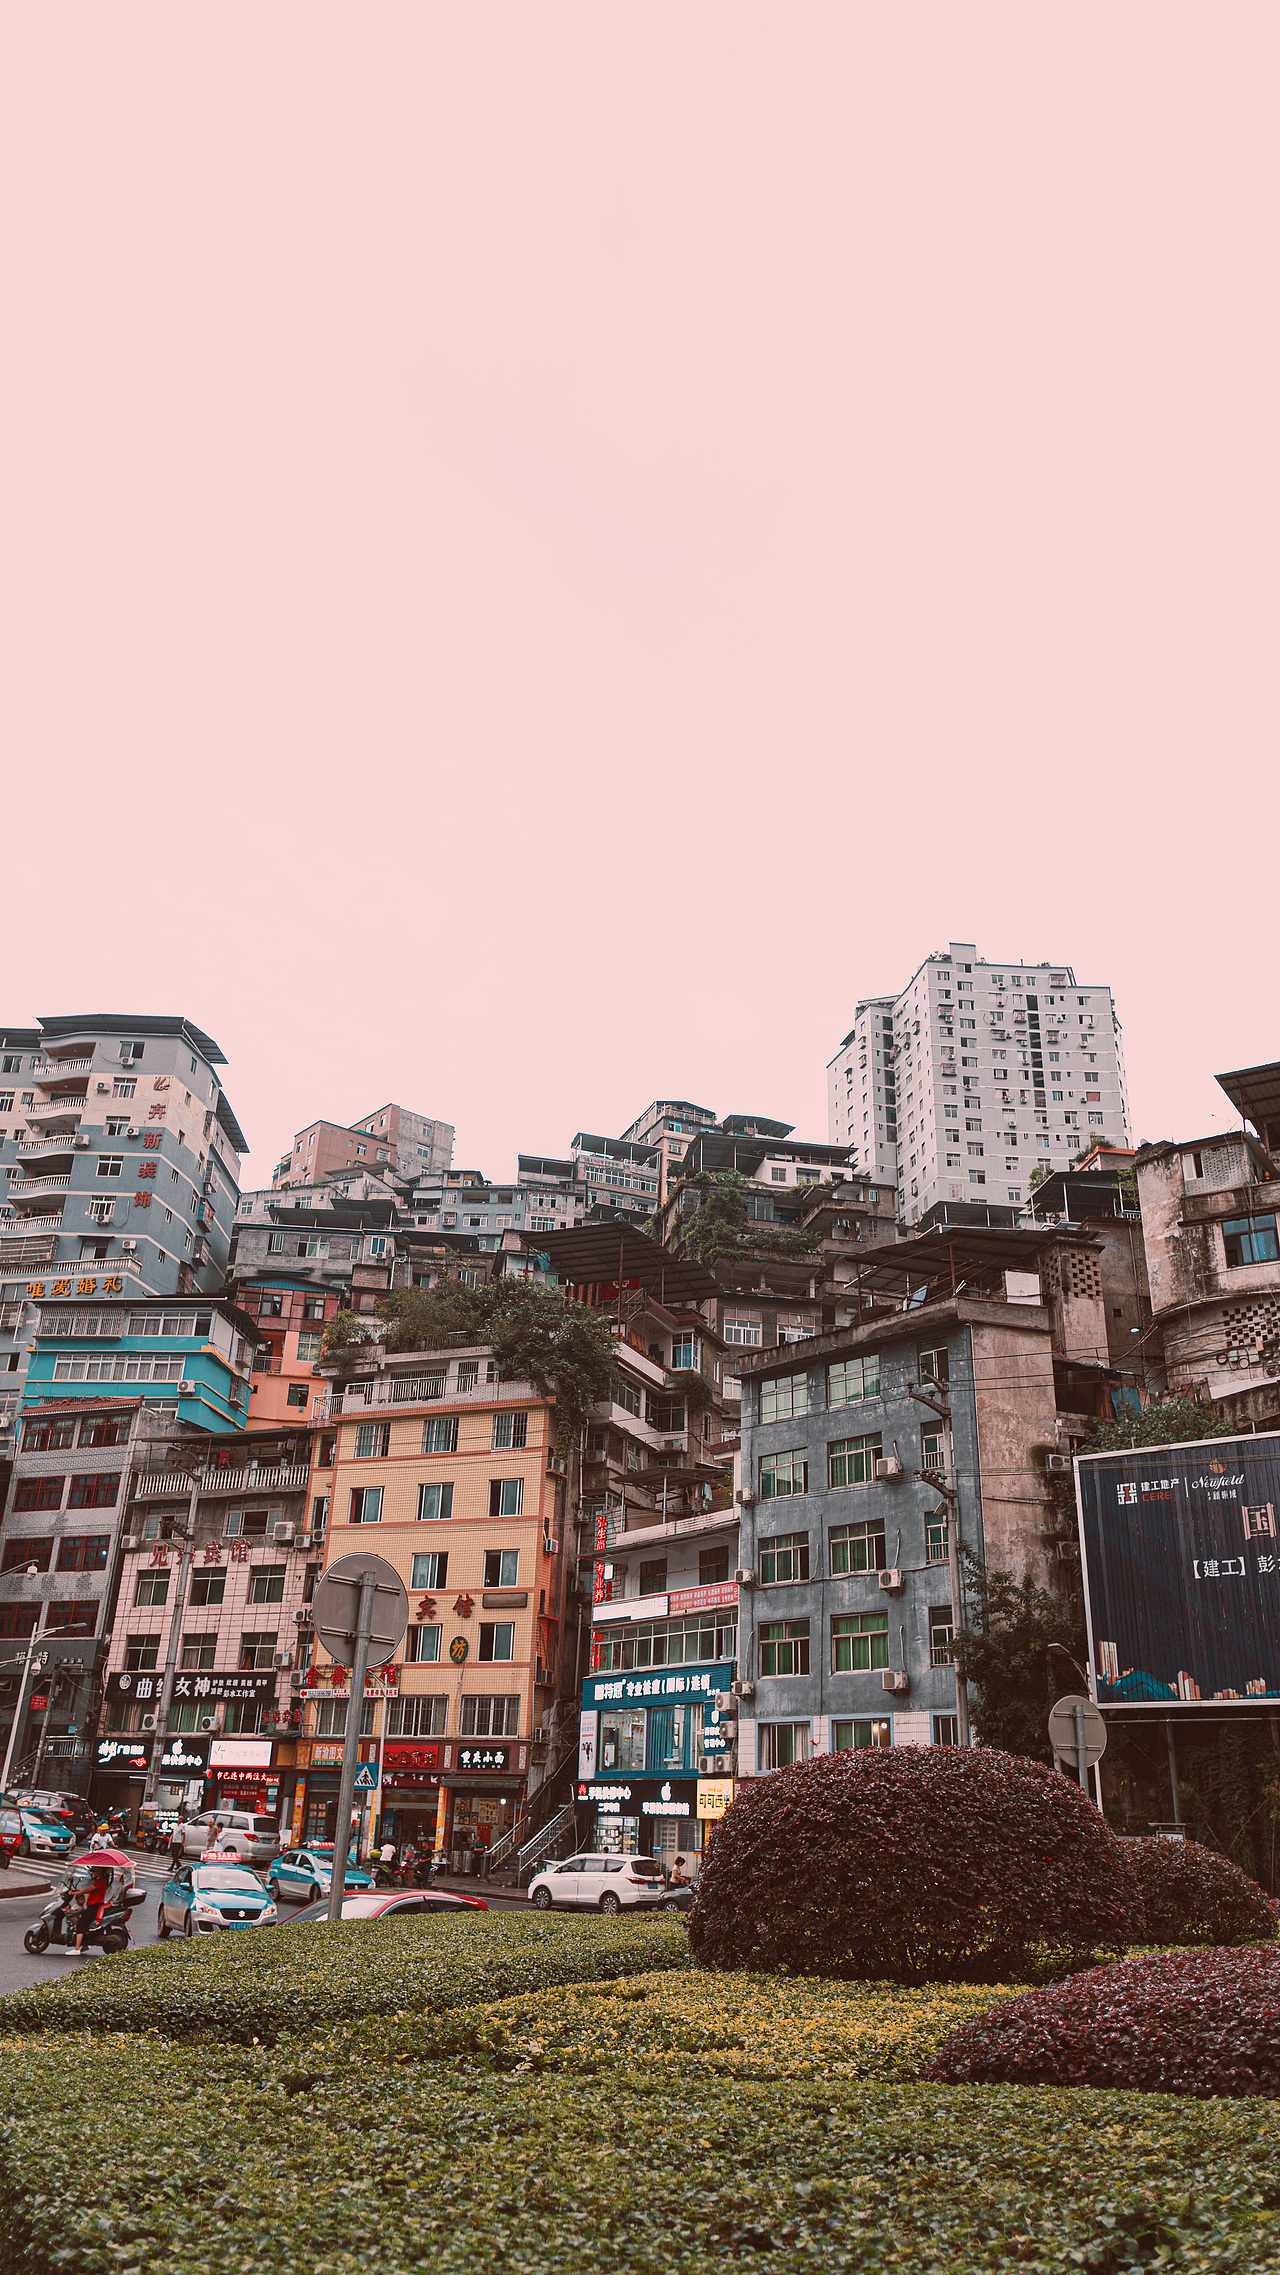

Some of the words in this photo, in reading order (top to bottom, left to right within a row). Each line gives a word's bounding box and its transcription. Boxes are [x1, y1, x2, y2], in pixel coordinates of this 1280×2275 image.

[25, 1276, 123, 1299] 唯爱婚礼
[1140, 1478, 1180, 1492] 建工地产
[1191, 1474, 1246, 1490] Newfield
[1142, 1491, 1172, 1502] CERE
[1192, 1556, 1247, 1580] 【建工】
[1257, 1554, 1280, 1574] 彭
[415, 1593, 476, 1621] 宾馆
[451, 1639, 467, 1660] 坊
